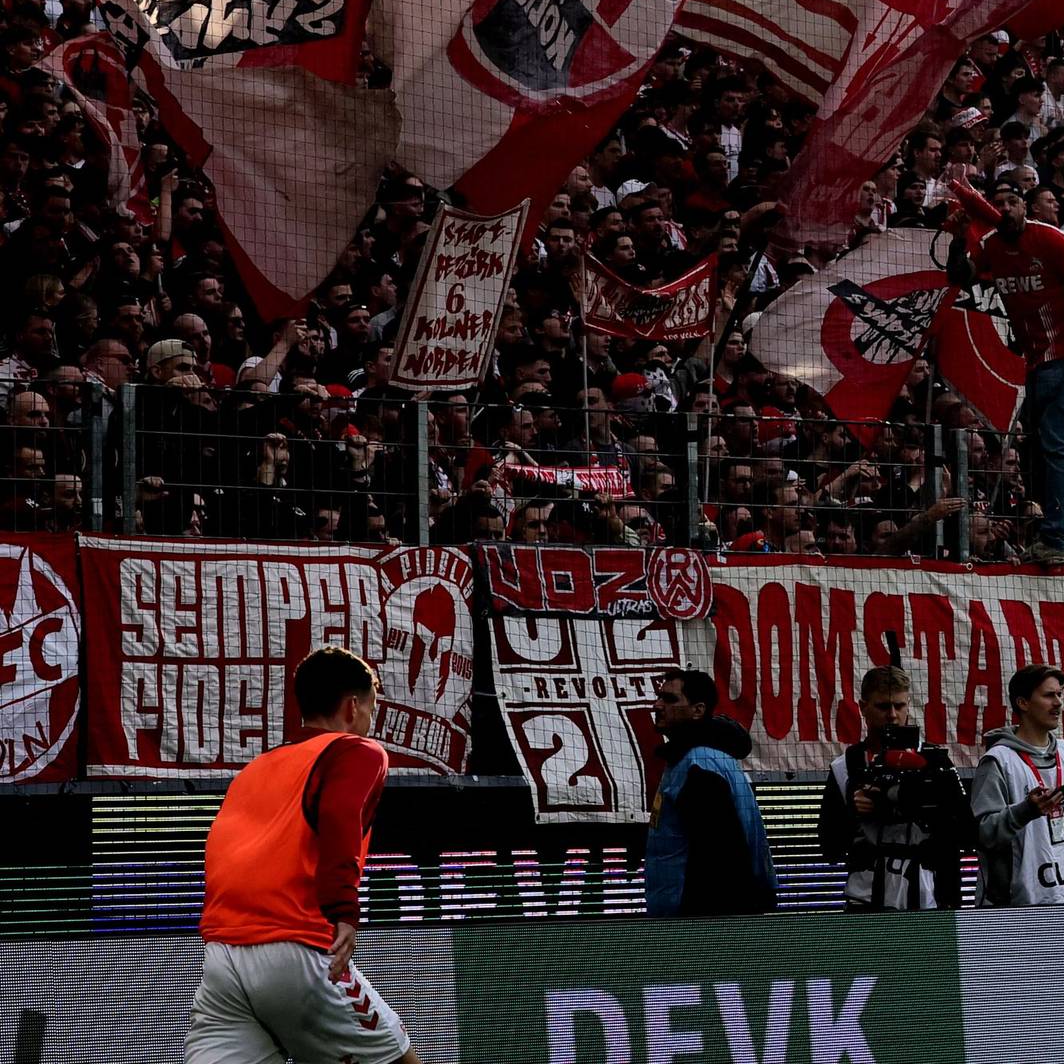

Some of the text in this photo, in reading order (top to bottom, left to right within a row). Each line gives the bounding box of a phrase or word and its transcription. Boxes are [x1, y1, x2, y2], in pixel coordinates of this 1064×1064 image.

[446, 283, 465, 314] 6
[995, 274, 1045, 295] REWE
[119, 557, 385, 660] SEMPER
[545, 975, 879, 1064] DEVK
